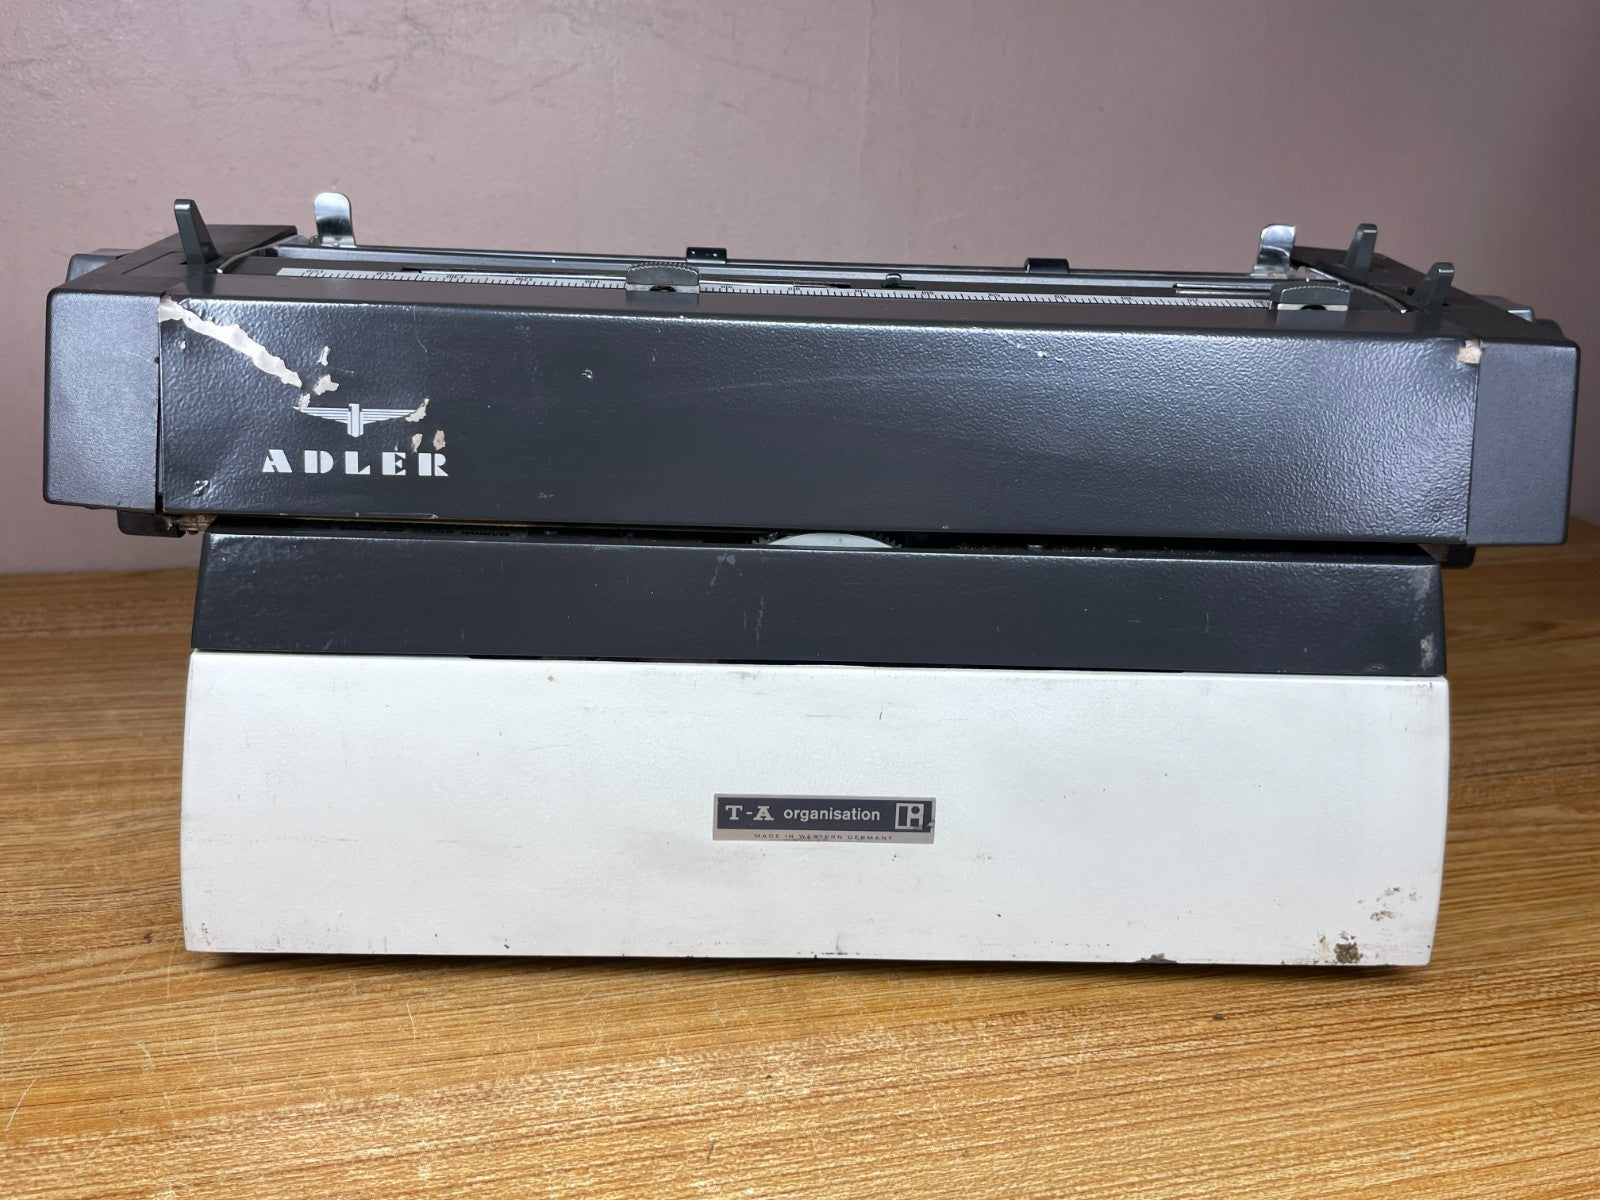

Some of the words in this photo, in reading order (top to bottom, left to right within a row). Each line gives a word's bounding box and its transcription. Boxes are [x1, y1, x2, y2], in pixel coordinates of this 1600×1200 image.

[262, 449, 449, 476] ADLER
[725, 805, 775, 821] T-A
[783, 806, 881, 822] organisation
